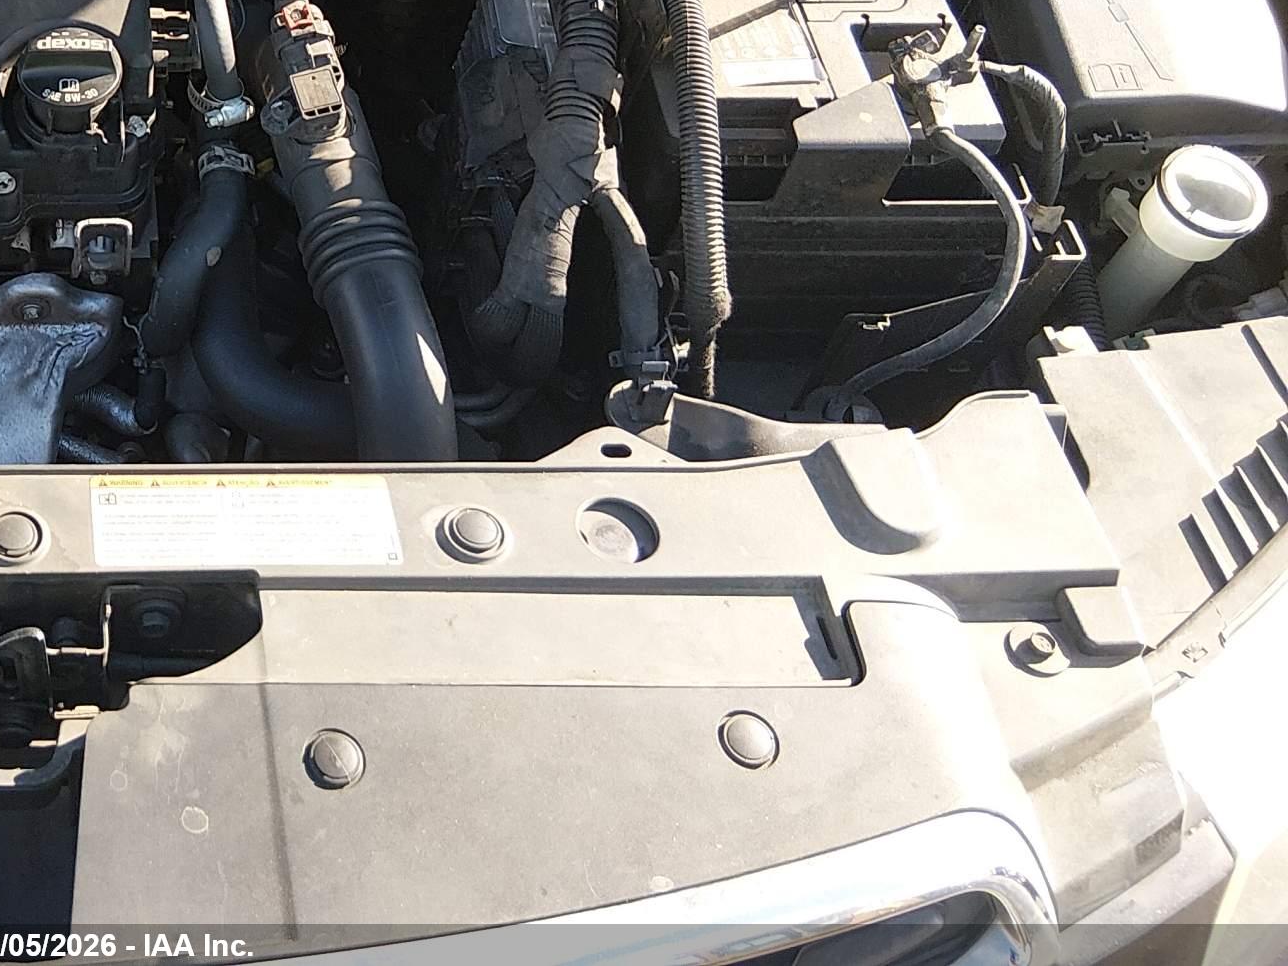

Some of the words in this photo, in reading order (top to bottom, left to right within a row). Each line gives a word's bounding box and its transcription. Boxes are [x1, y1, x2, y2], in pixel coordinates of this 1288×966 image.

[36, 35, 107, 51] dexos
[42, 88, 62, 102] SAE
[64, 87, 99, 103] 5W-30
